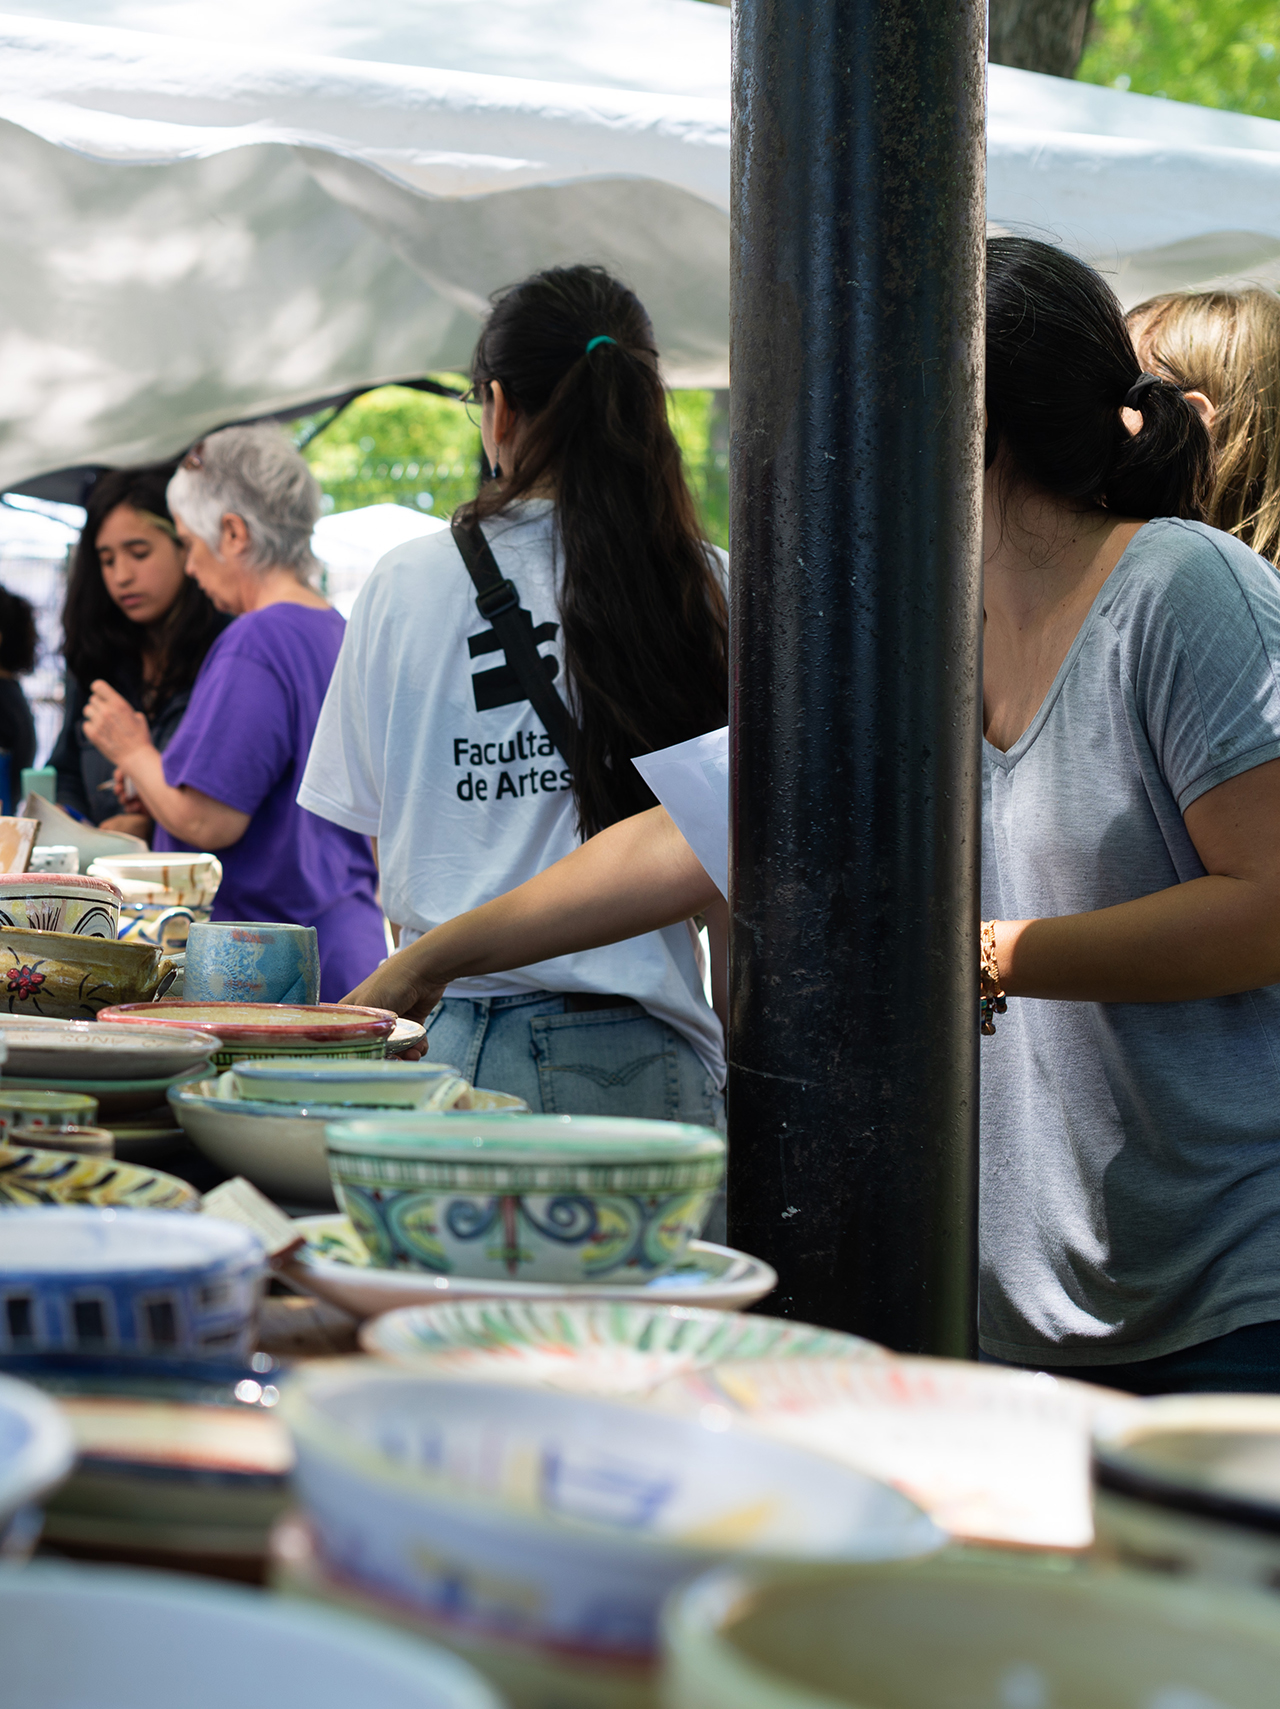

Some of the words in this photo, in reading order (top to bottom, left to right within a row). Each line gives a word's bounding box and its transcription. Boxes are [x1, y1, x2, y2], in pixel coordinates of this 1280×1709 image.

[453, 730, 555, 766] Faculta
[456, 771, 488, 801] de
[495, 767, 575, 800] Artes
